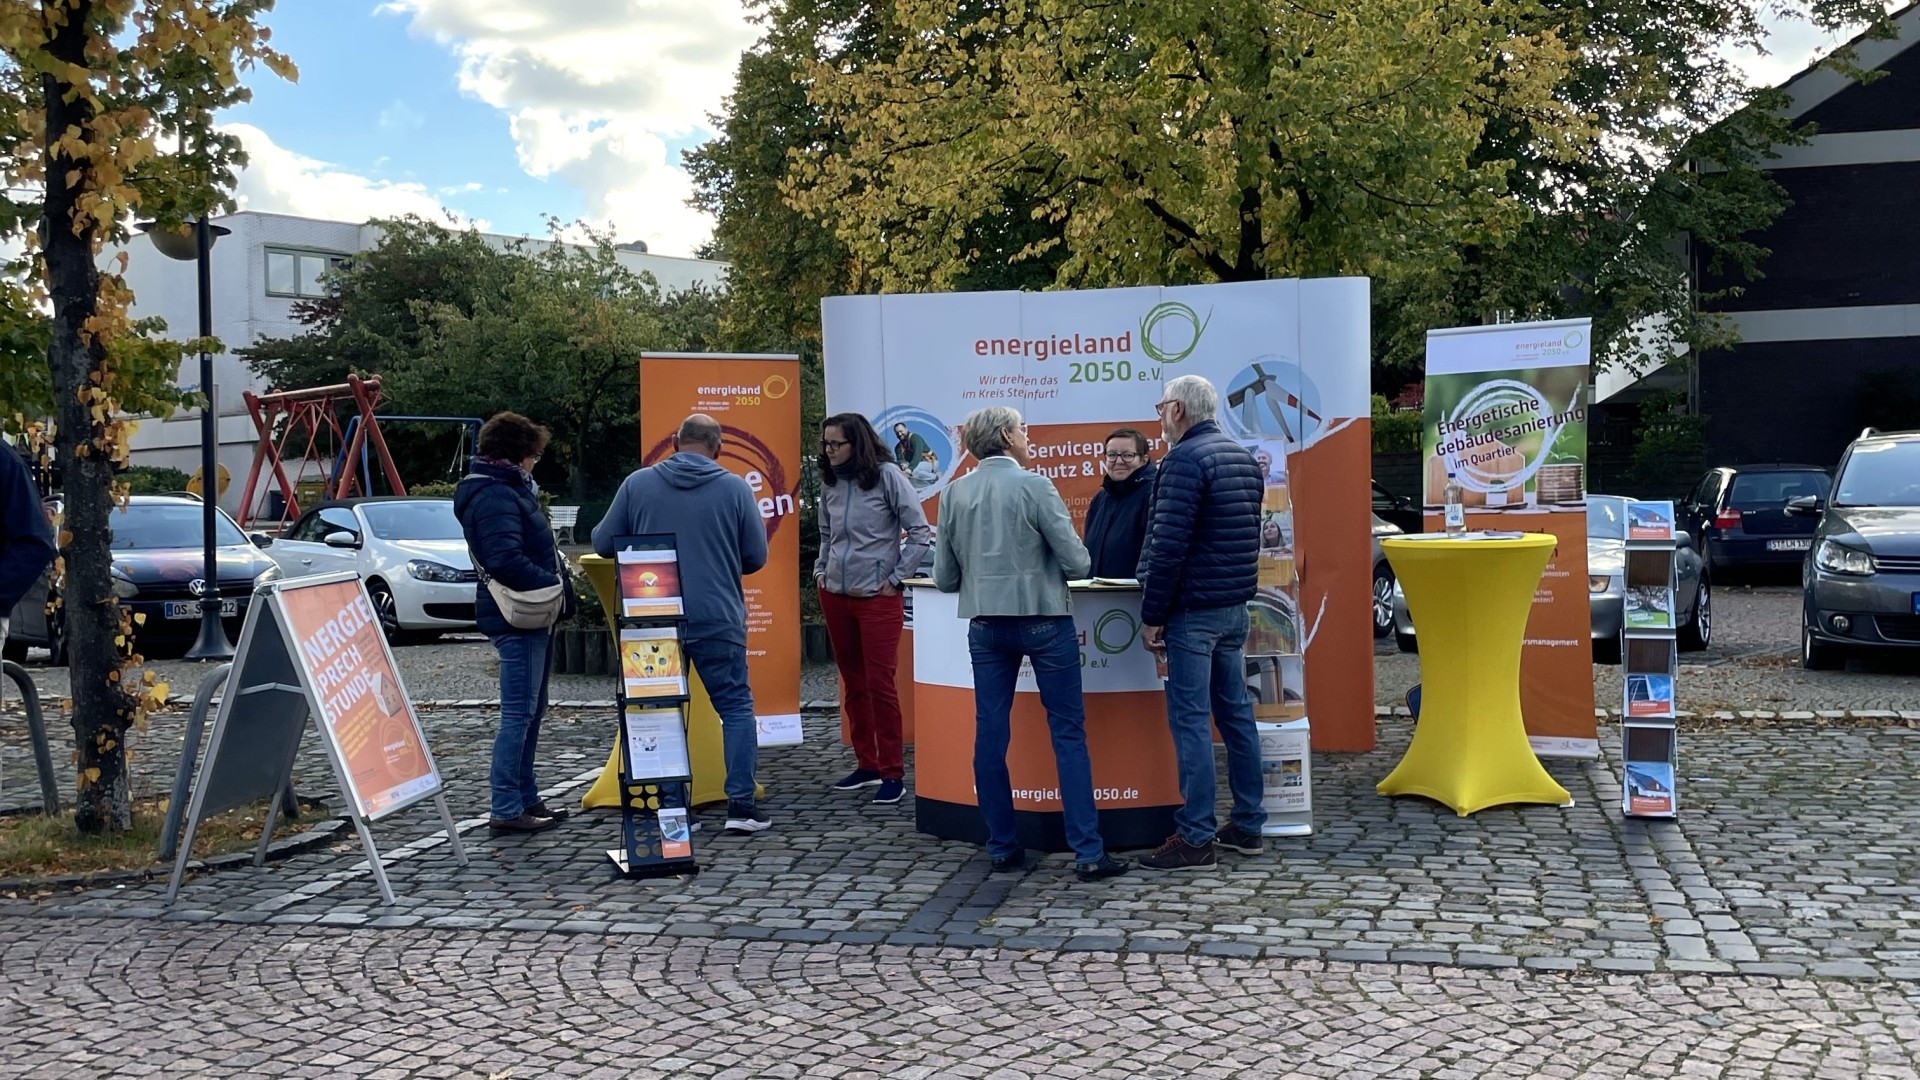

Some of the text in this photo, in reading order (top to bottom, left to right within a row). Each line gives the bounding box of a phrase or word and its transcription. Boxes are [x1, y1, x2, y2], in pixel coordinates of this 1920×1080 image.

[974, 331, 1131, 361] energieland
[1515, 339, 1562, 350] energieland
[1068, 360, 1132, 383] 2050
[979, 374, 1058, 386] Wir drehen das
[697, 385, 761, 396] energieland
[962, 387, 1059, 400] im Kreis Steinfurt!
[735, 396, 761, 406] 2050
[1437, 399, 1540, 436] Energetische
[1435, 408, 1586, 457] Gebäudesanierung
[1454, 444, 1518, 469] im Quartier
[1081, 460, 1095, 477] &
[174, 604, 187, 615] OS
[303, 594, 373, 671] NERGIE
[1090, 658, 1110, 668] e.V.
